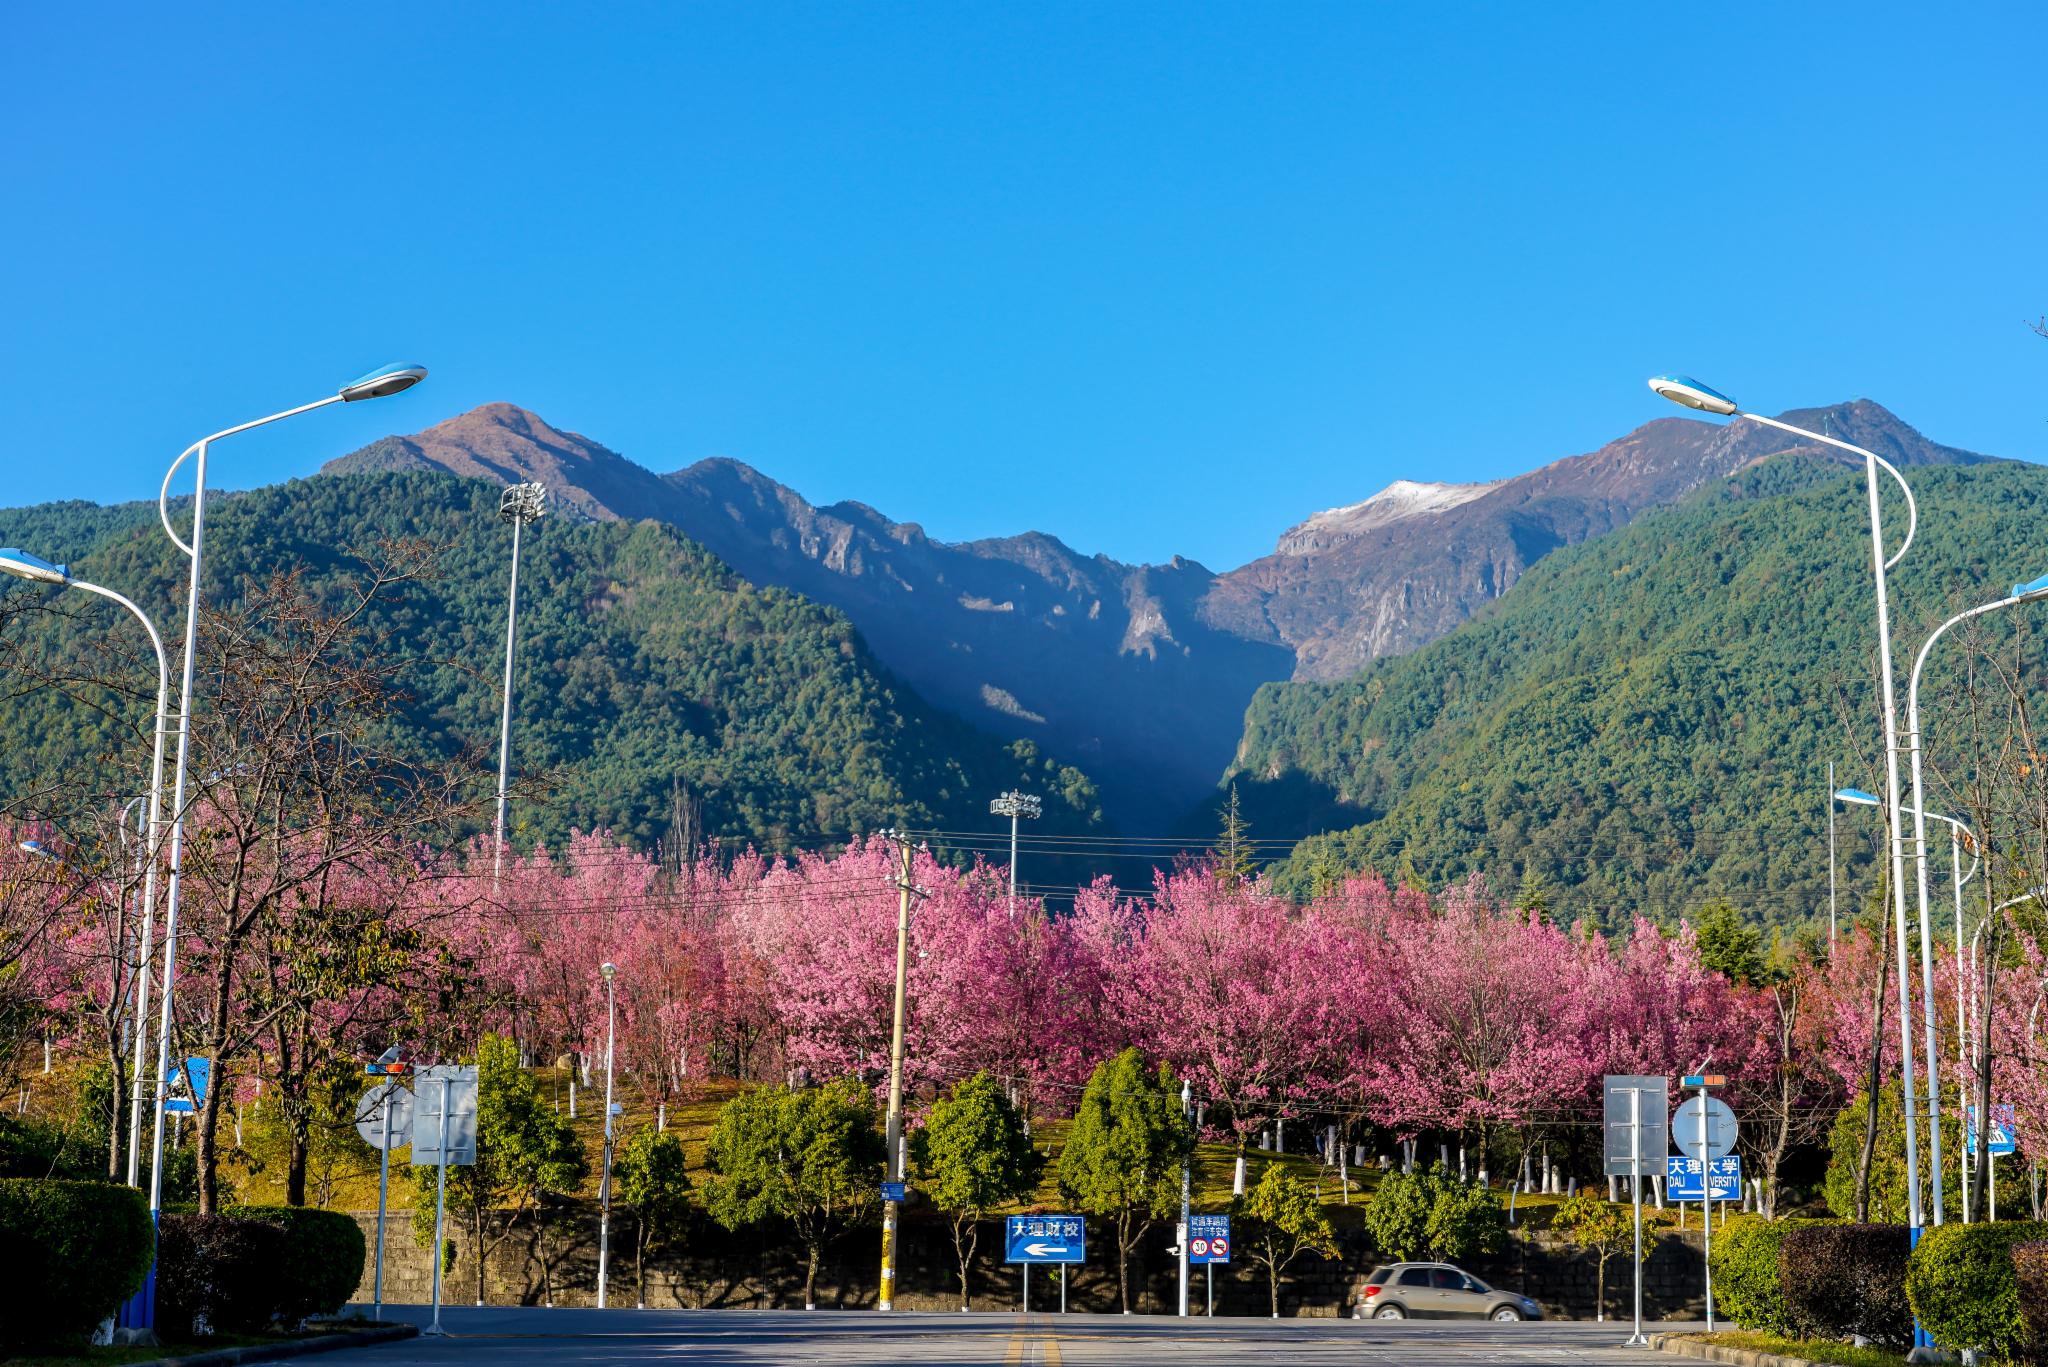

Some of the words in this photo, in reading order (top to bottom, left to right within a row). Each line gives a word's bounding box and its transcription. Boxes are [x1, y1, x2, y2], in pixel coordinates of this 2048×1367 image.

[1669, 1175, 1685, 1187] DALI
[1700, 1175, 1738, 1188] UVERSITY
[1012, 1221, 1079, 1237] 大理财校
[1195, 1242, 1206, 1252] 30
